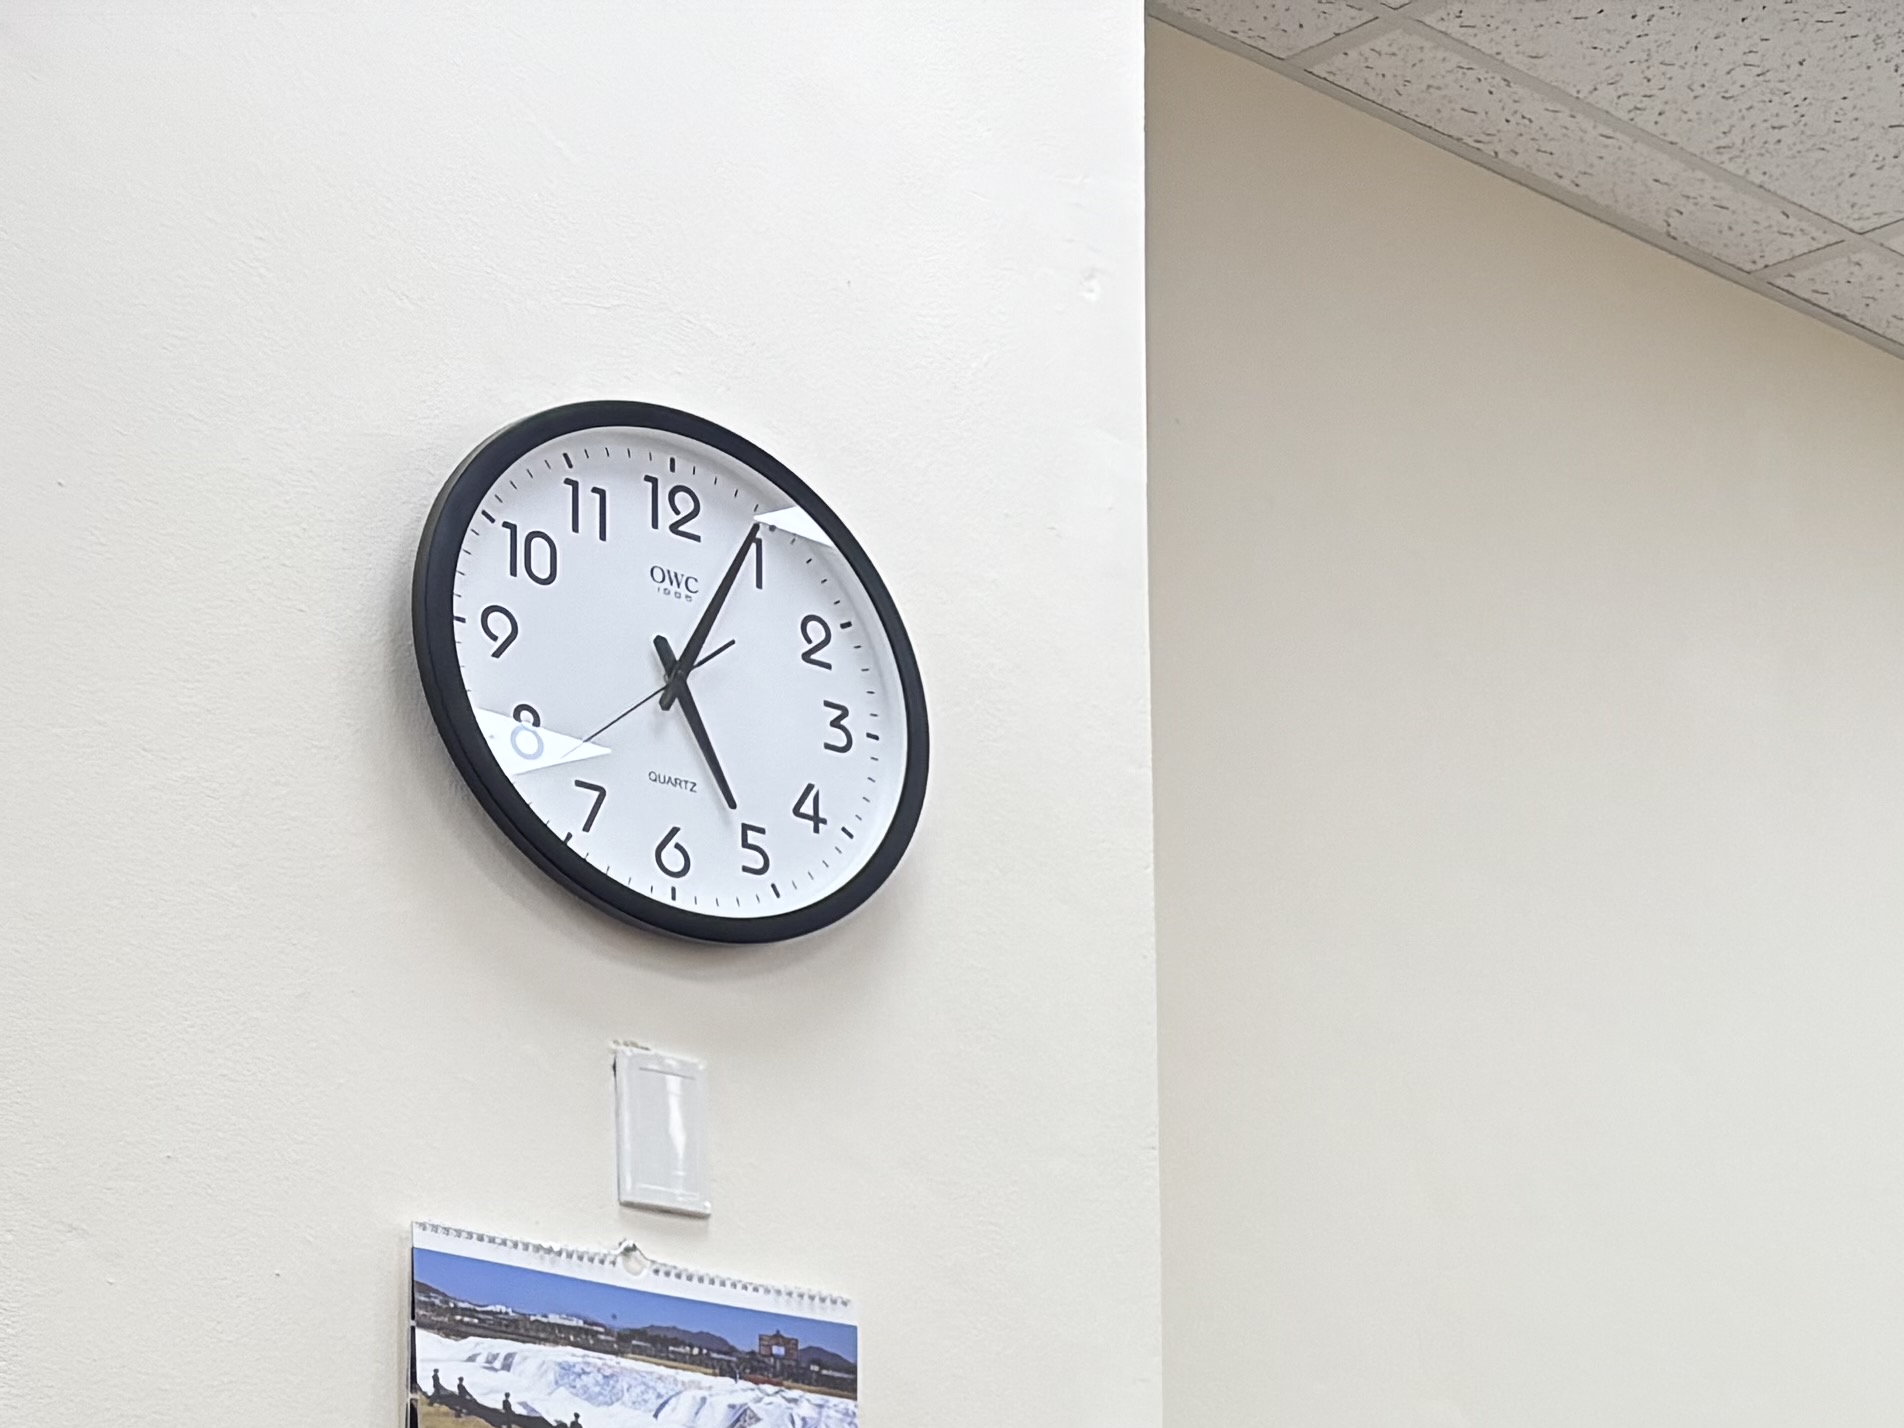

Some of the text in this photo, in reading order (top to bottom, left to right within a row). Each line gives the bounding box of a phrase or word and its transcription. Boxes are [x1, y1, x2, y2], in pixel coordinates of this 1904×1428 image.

[563, 477, 607, 542] 11
[643, 475, 702, 543] 12
[501, 520, 558, 586] 10
[650, 565, 699, 594] OWC
[751, 537, 763, 590] 1
[480, 605, 519, 659] 9
[800, 614, 833, 671] 2
[510, 703, 545, 760] 8
[823, 699, 853, 754] 3
[574, 779, 607, 833] 7
[648, 771, 697, 793] QUARTZ
[791, 783, 828, 834] 4
[654, 826, 691, 879] 6
[740, 822, 770, 876] 5
